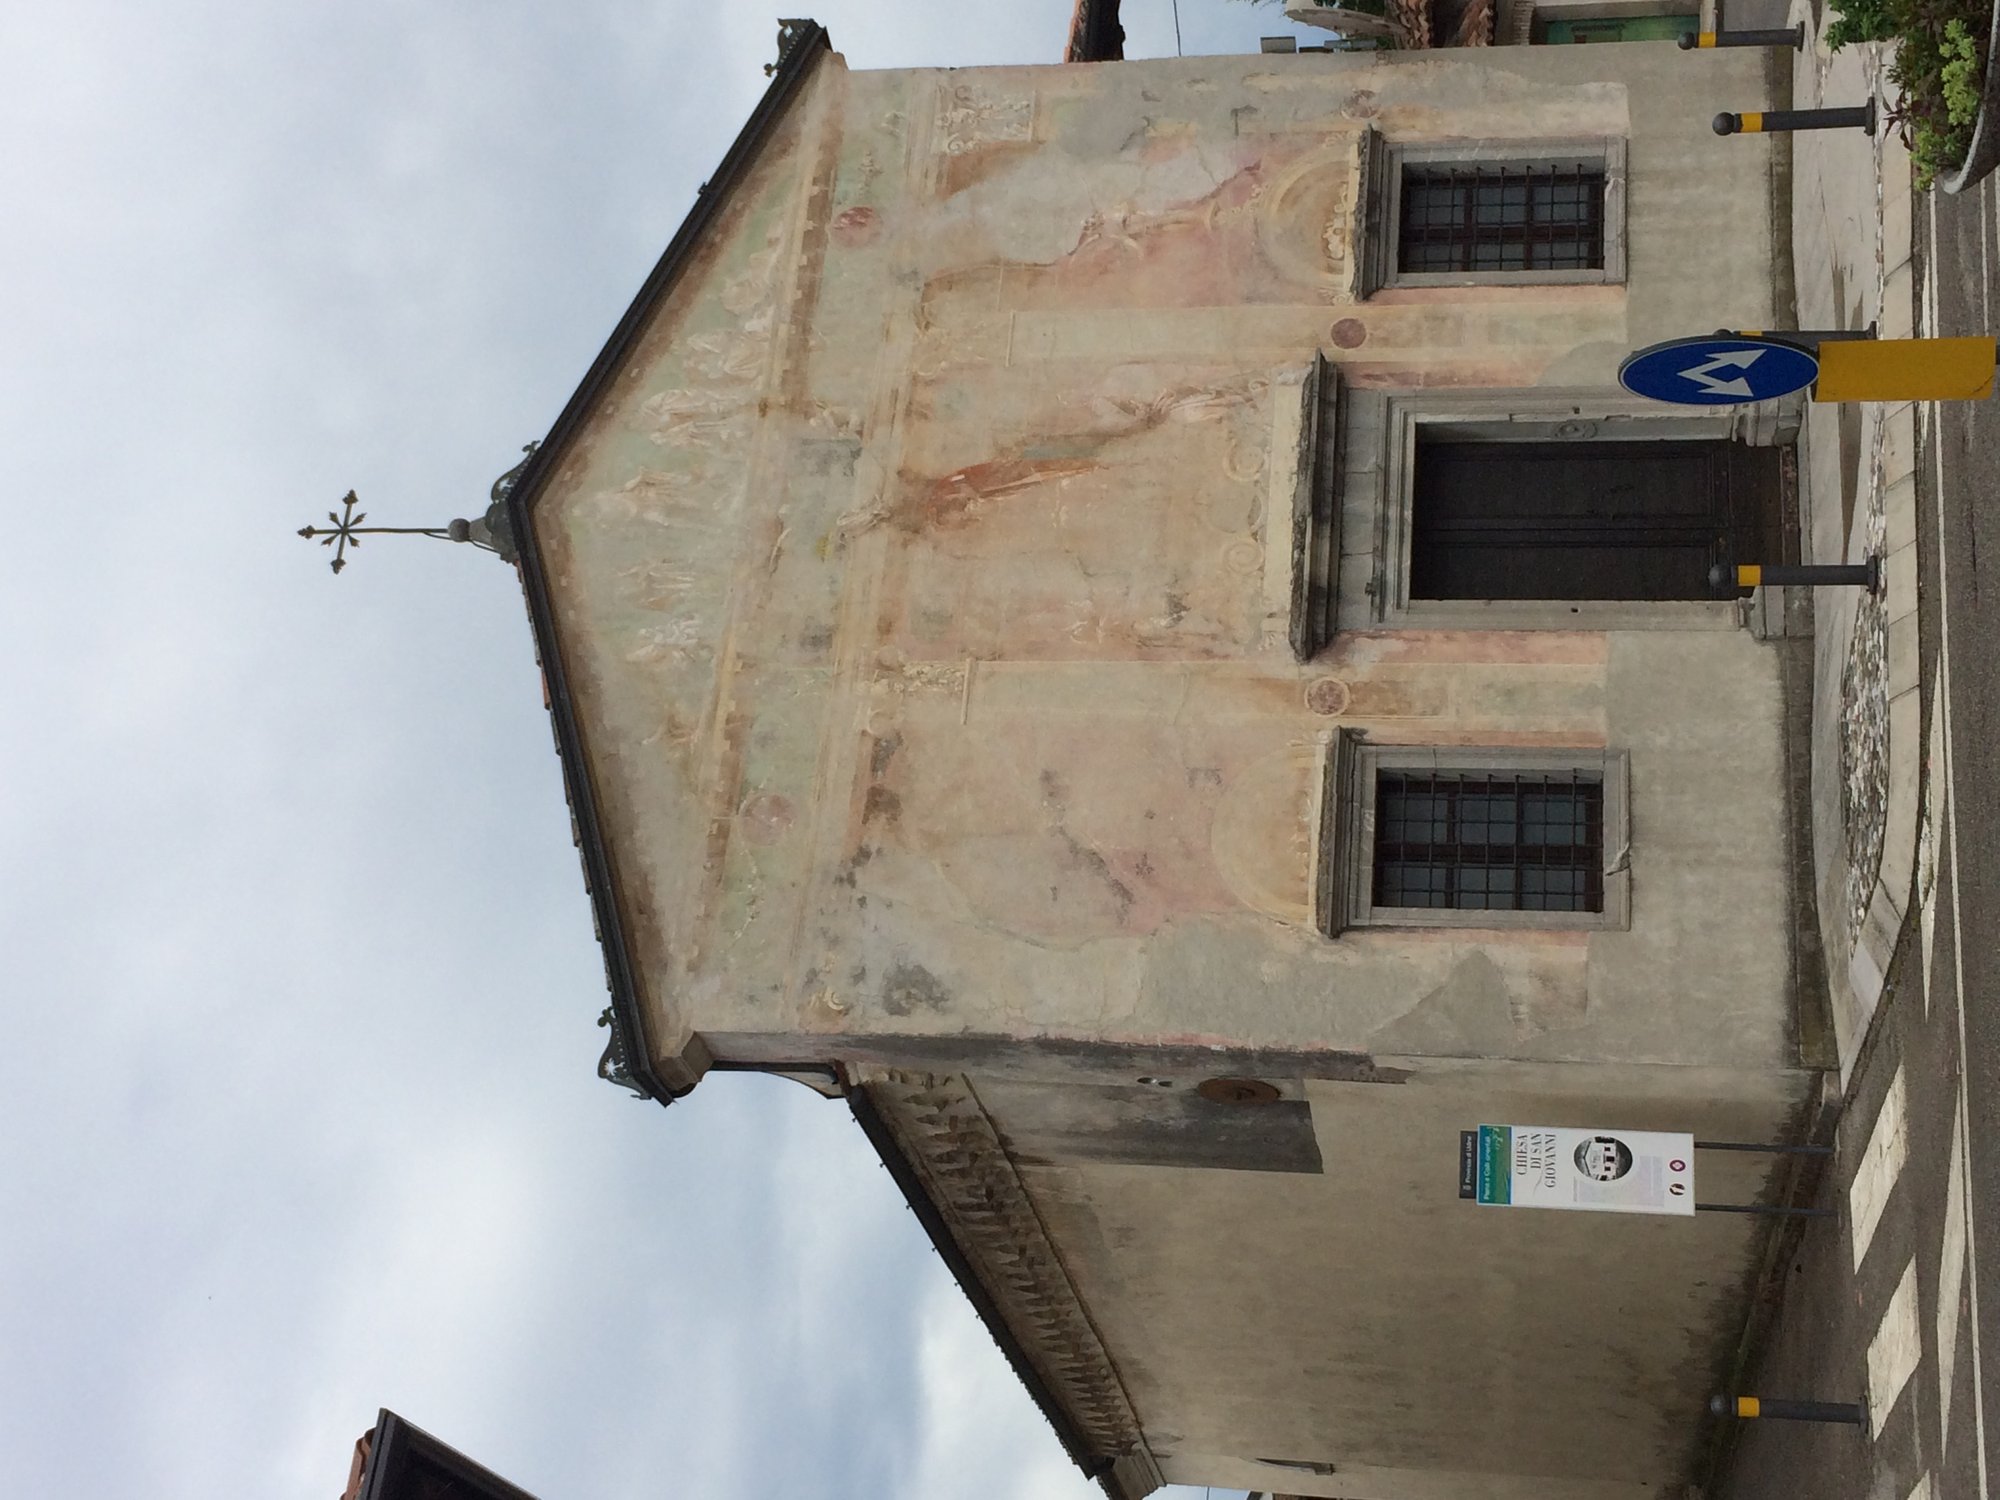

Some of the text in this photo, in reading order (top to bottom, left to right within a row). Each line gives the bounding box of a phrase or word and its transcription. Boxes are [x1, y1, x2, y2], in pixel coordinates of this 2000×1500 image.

[1516, 1135, 1527, 1175] CHIESA
[1530, 1133, 1542, 1169] DI SAN
[1544, 1134, 1556, 1188] GIOVANNI
